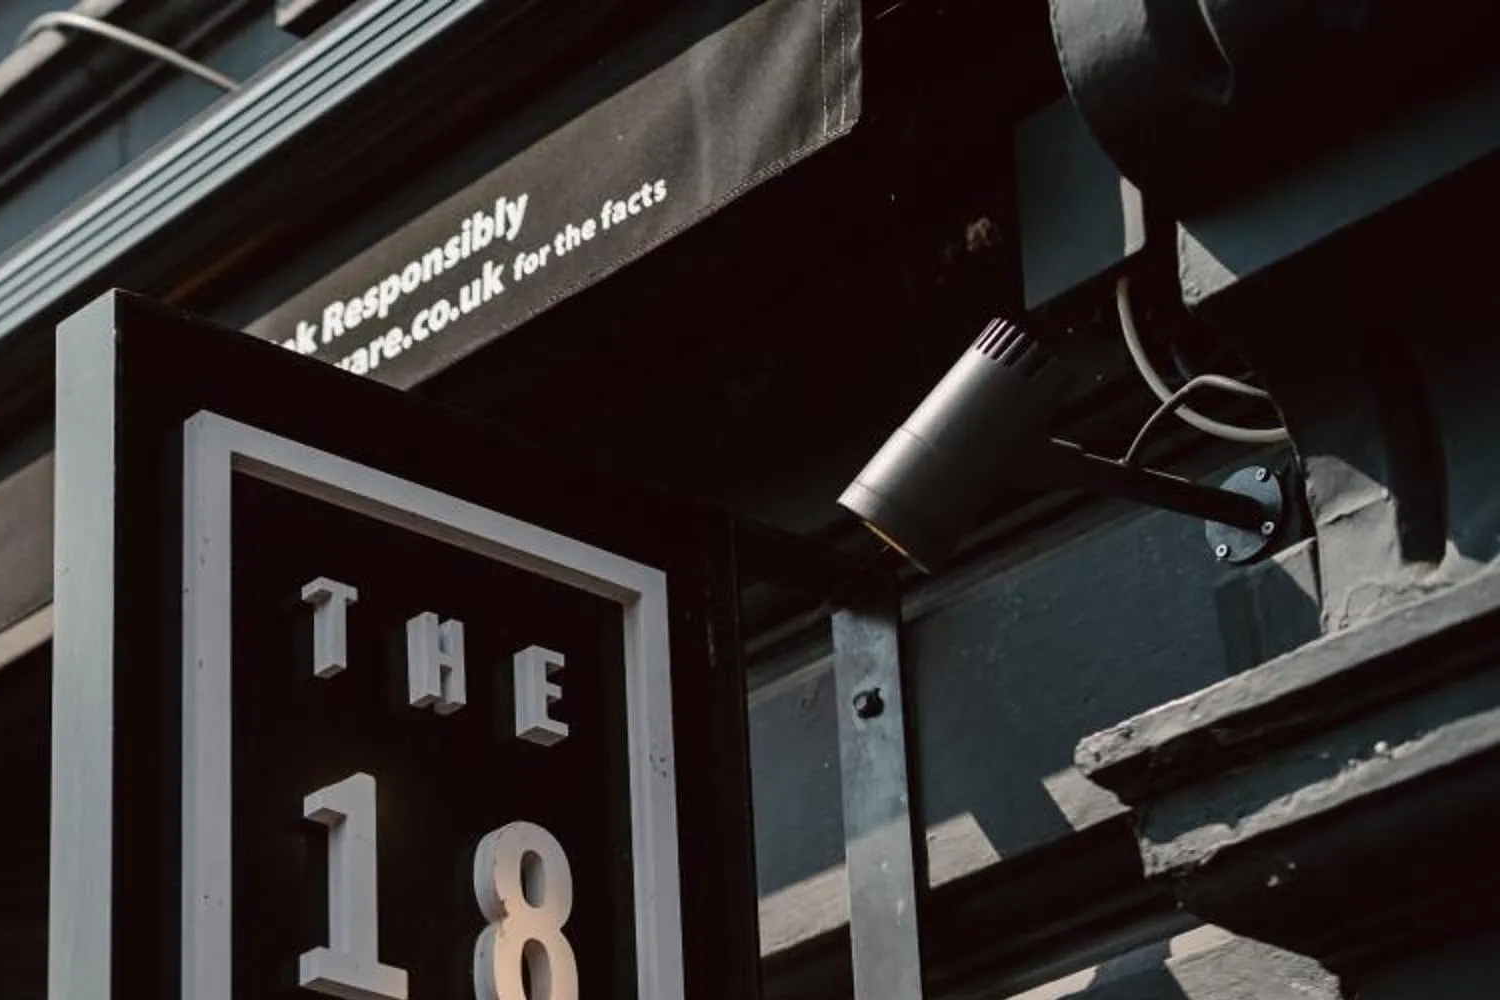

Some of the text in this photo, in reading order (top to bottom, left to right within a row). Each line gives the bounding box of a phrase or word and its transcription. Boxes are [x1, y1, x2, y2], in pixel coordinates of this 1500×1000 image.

[321, 193, 528, 344] Responsibly
[512, 244, 551, 281] for
[553, 216, 597, 257] the
[600, 178, 667, 230] facts
[301, 576, 569, 746] THE
